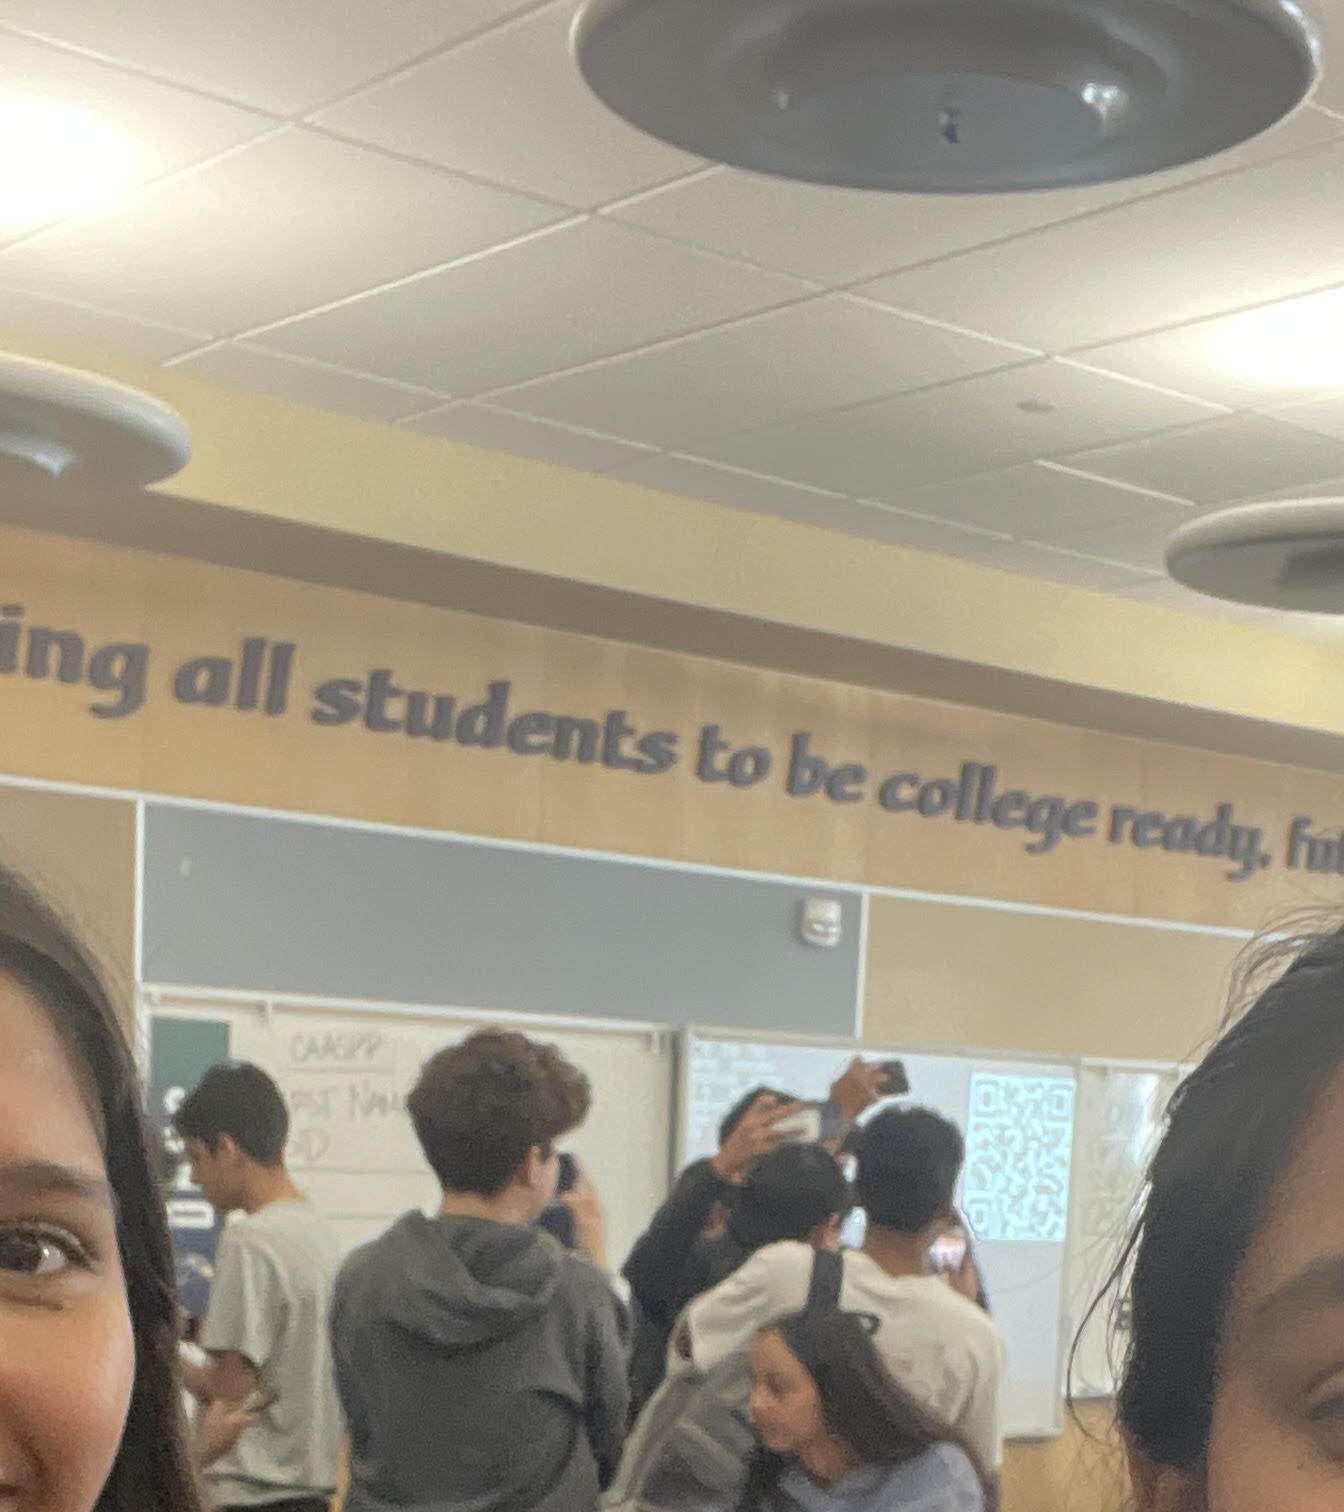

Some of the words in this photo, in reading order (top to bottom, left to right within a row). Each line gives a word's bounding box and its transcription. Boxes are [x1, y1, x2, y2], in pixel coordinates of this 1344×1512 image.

[172, 636, 296, 716] all
[310, 669, 679, 775] students
[695, 724, 772, 789] to
[784, 731, 867, 805] be
[878, 761, 1099, 856] college
[1108, 800, 1273, 884] ready,
